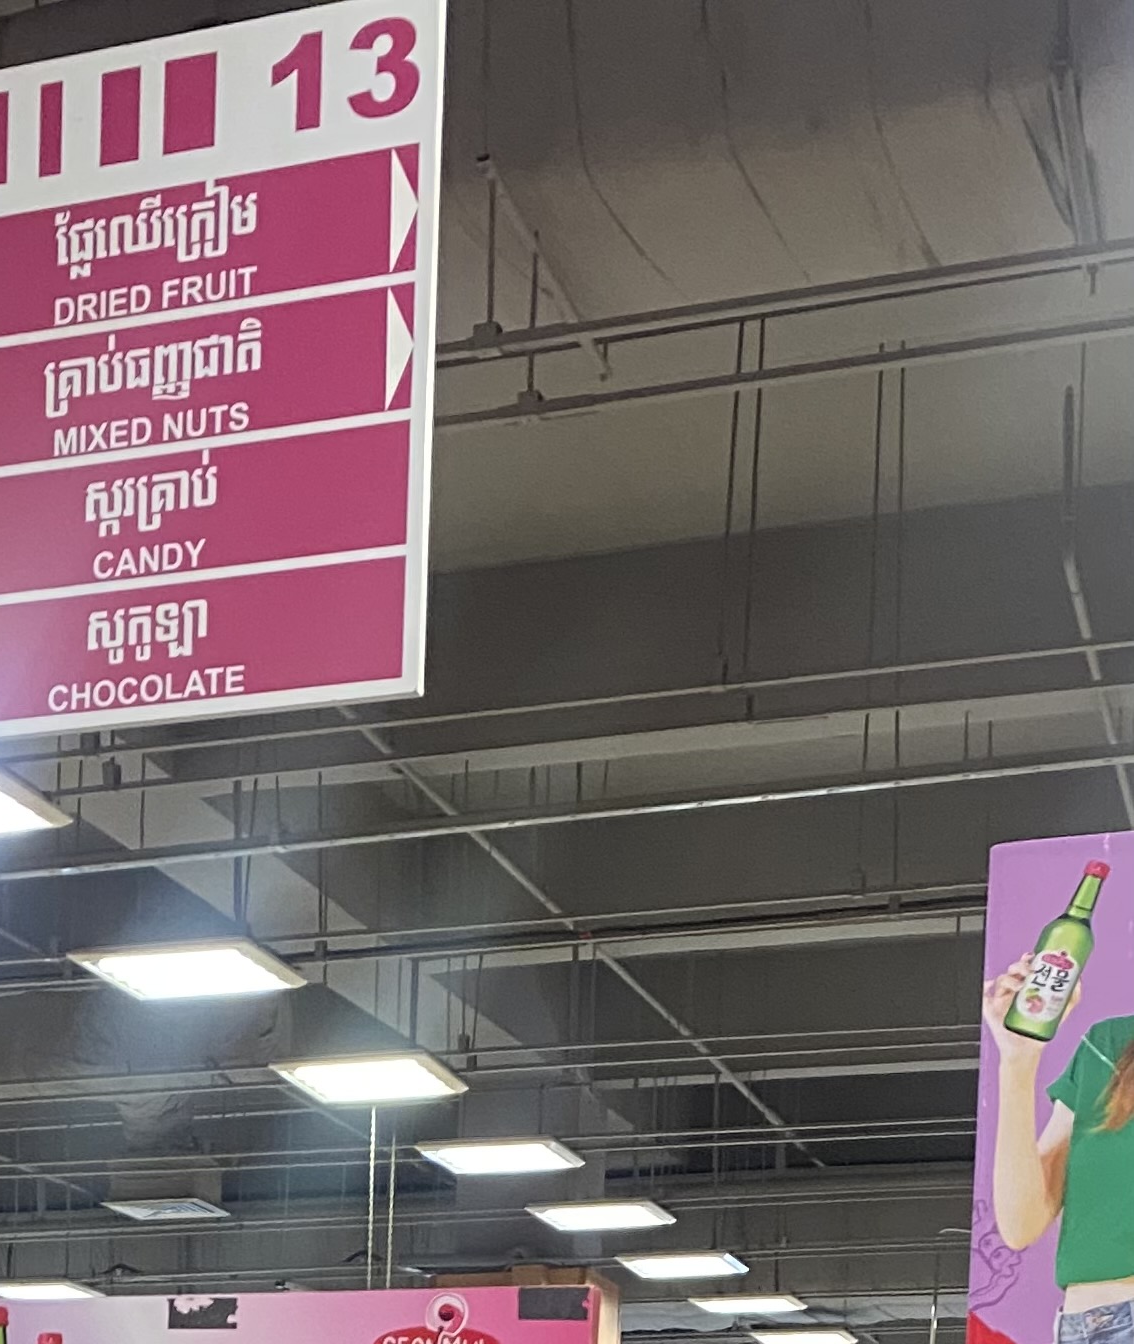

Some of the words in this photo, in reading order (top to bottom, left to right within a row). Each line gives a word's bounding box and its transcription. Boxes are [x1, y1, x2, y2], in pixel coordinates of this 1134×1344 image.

[270, 18, 421, 133] 13
[53, 285, 152, 326] DRIED
[161, 266, 258, 315] FRUIT
[53, 417, 152, 457] MIXED
[163, 402, 250, 443] NUTS
[92, 539, 207, 581] CANDY
[48, 666, 245, 713] CHOCOLATE
[1032, 963, 1070, 992] 선물
